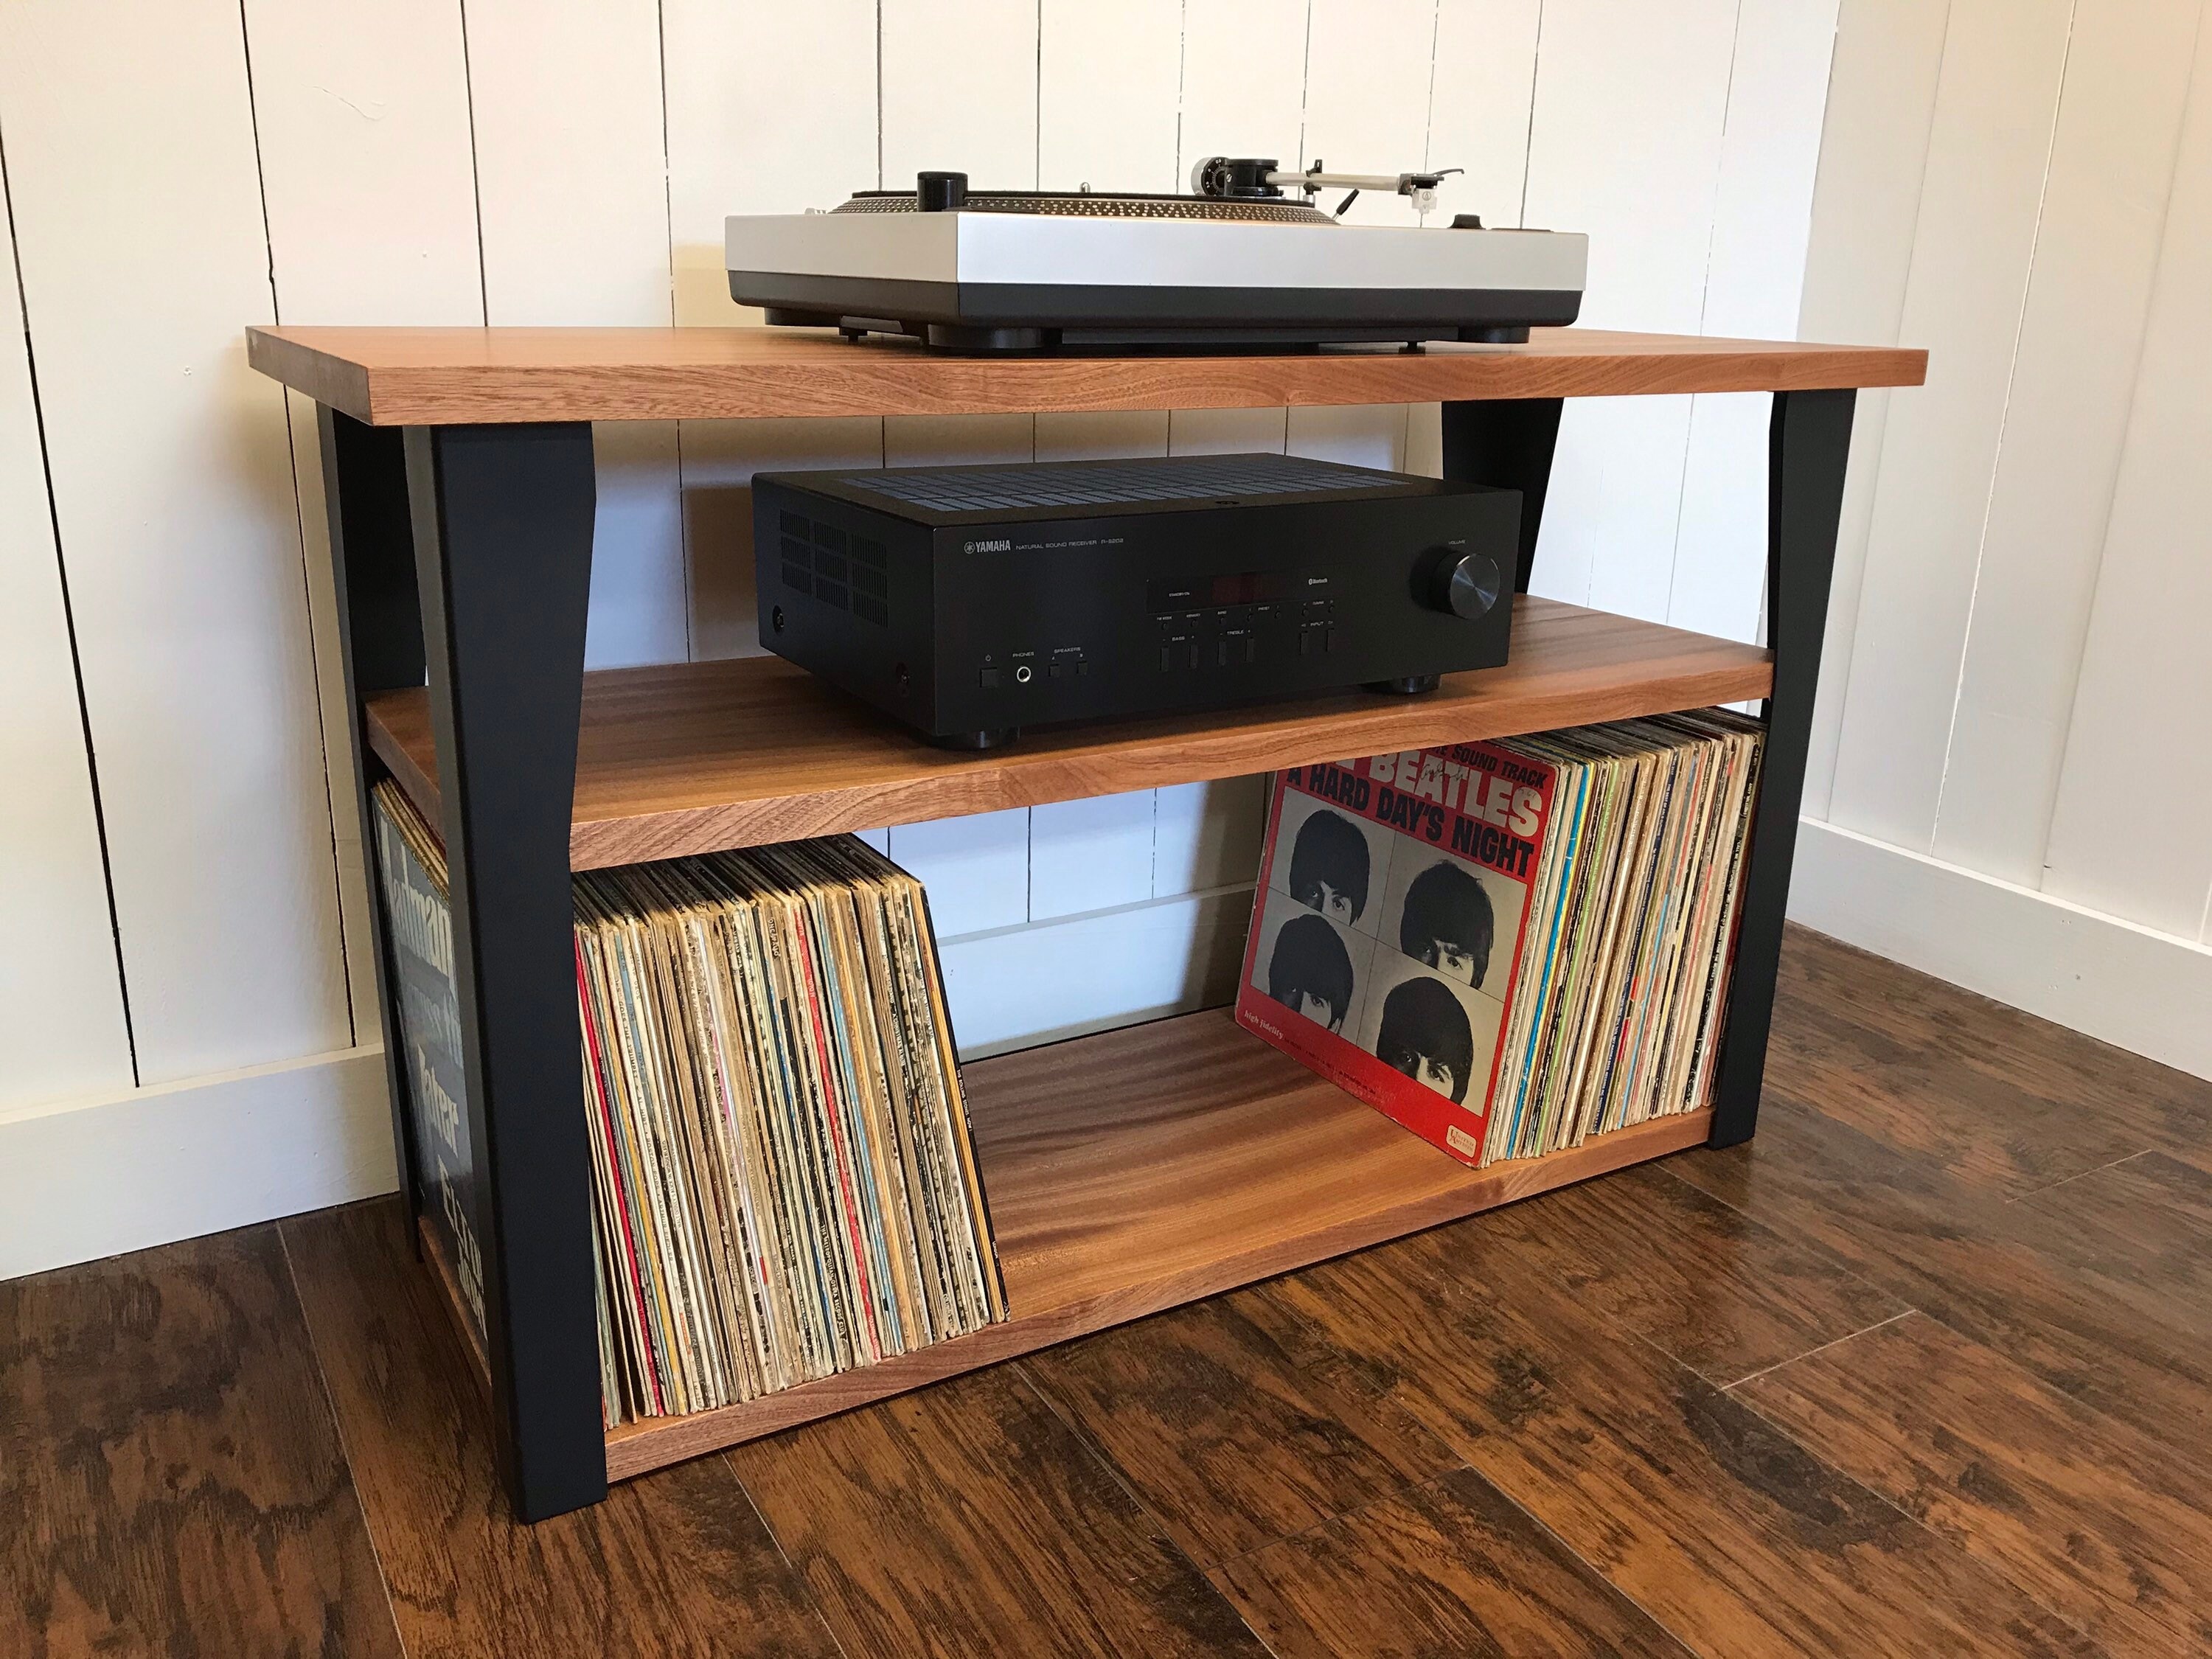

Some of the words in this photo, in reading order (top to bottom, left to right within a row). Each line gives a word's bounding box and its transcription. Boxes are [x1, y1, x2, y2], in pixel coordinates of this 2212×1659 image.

[975, 540, 1011, 553] YAMAHA
[1451, 745, 1498, 773] SOUND
[1501, 760, 1548, 790] TRACK
[1369, 750, 1543, 838] BEATLES
[1287, 765, 1301, 787] A
[1309, 764, 1371, 812] HARD
[1376, 787, 1445, 842] DAY'S
[1451, 816, 1535, 878] NIGHT
[892, 1018, 902, 1047] CHRISTMAS
[618, 999, 627, 1022] GOES
[627, 1043, 638, 1079] TRUMPET
[657, 1197, 667, 1228] ARTHUR
[821, 1236, 835, 1277] METROPOLITAN
